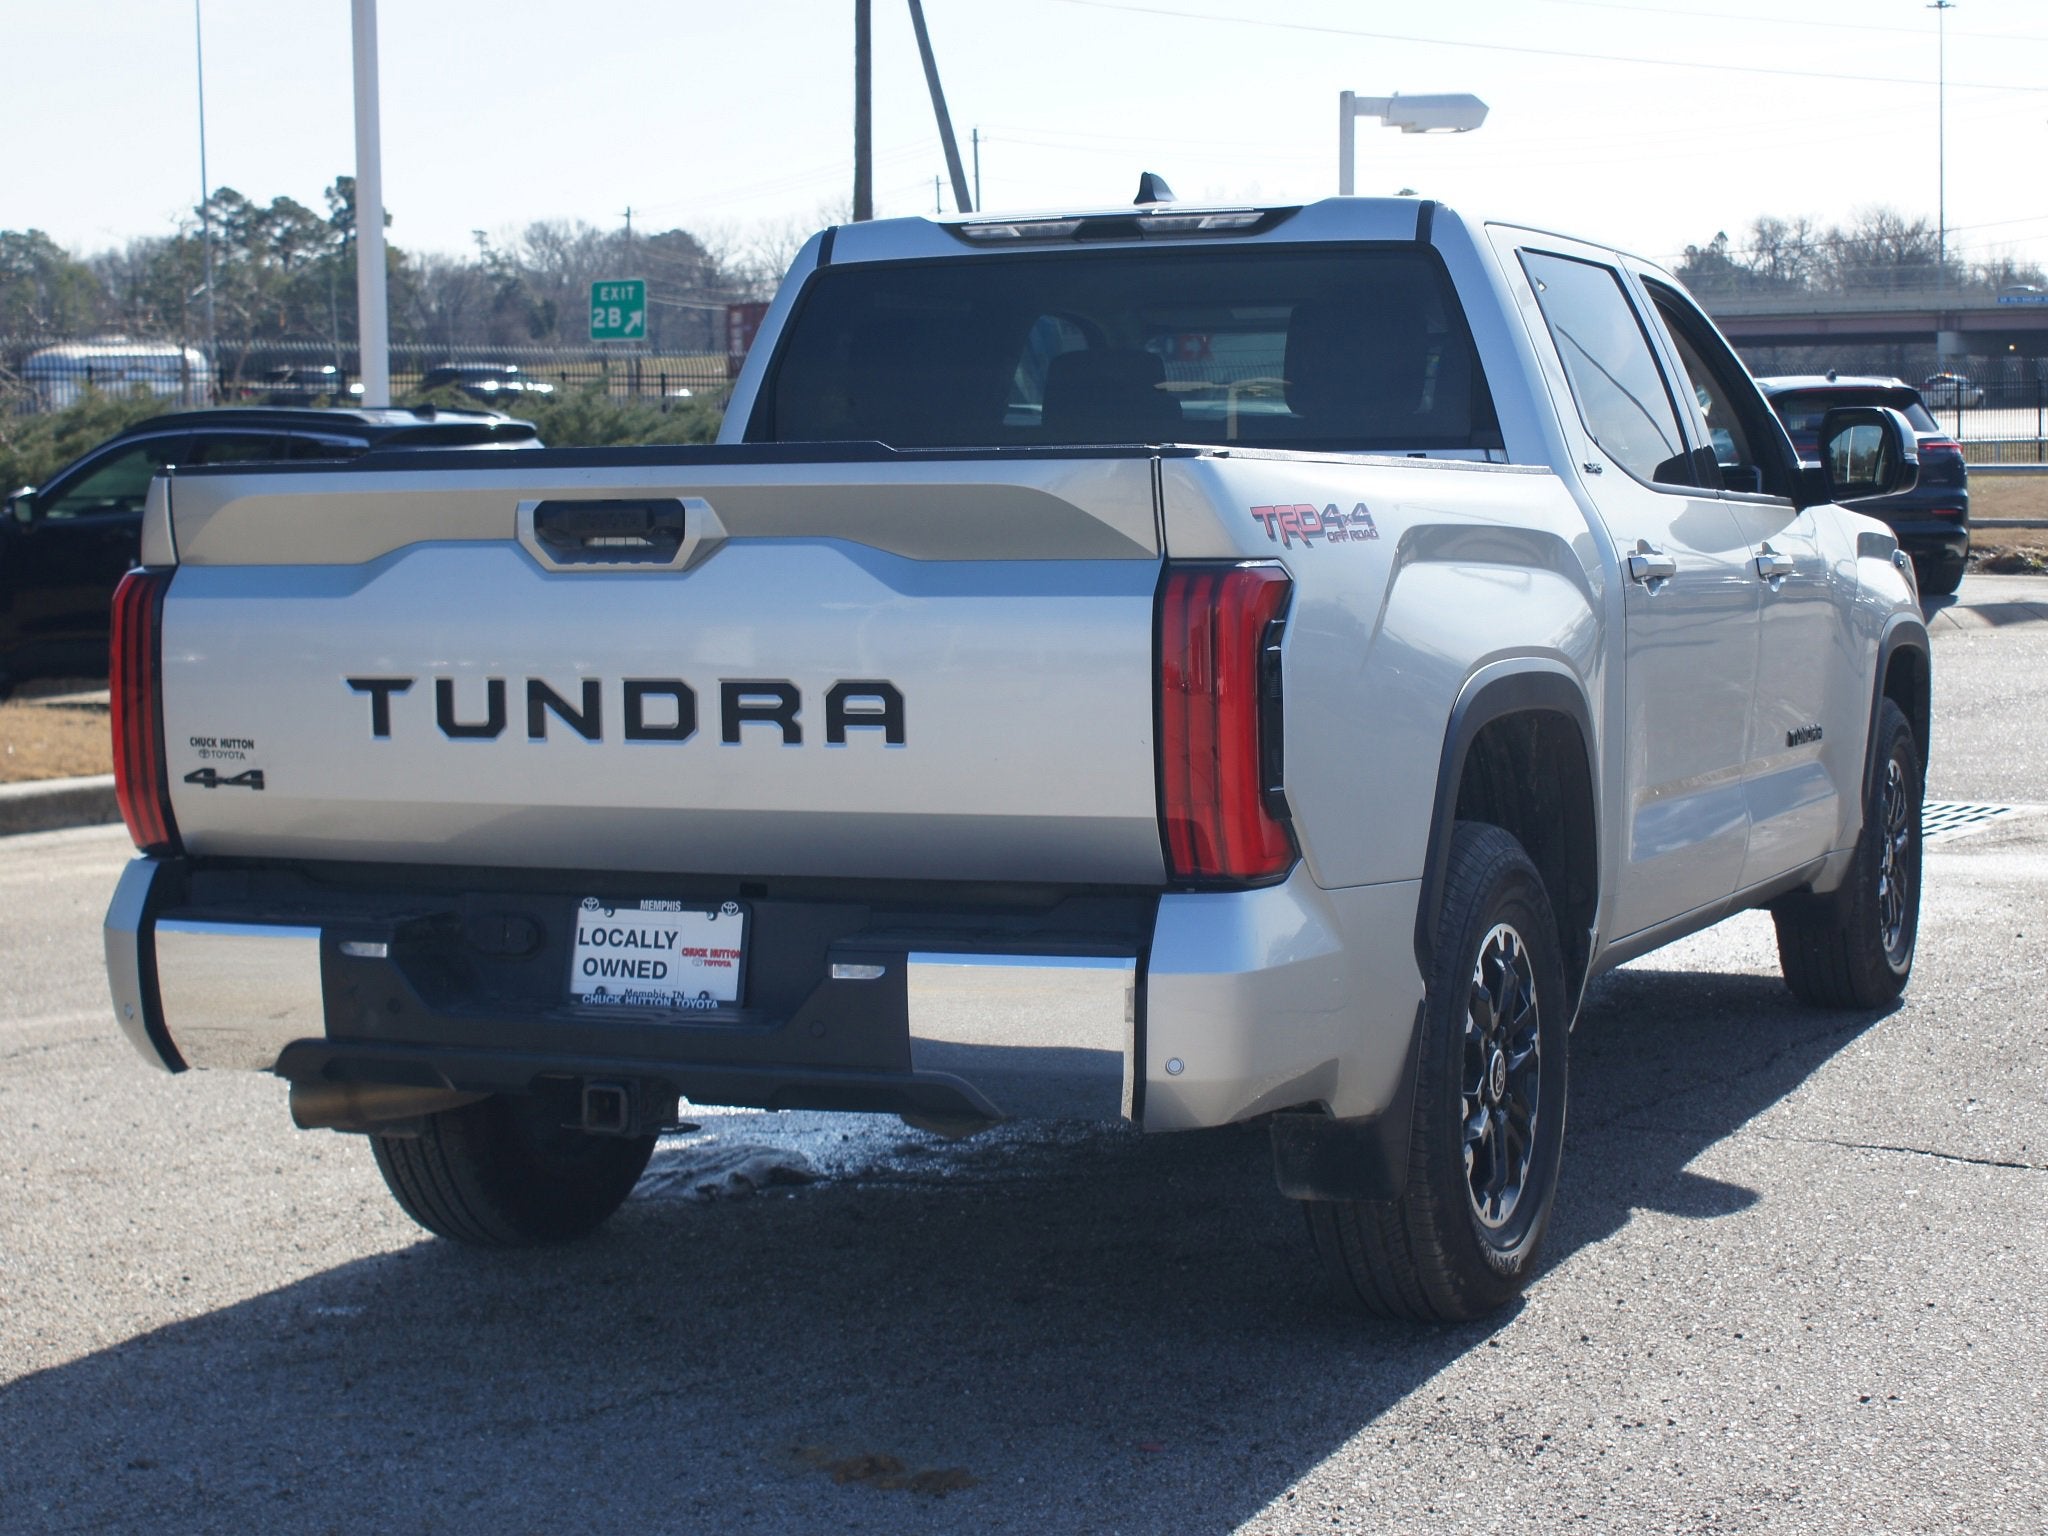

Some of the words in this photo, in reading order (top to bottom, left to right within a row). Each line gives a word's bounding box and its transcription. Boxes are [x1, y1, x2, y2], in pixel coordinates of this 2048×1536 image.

[601, 286, 635, 301] EXIT
[592, 307, 621, 328] 2B
[1326, 530, 1349, 544] OFF
[1350, 528, 1380, 542] ROAD
[346, 676, 906, 748] TUNDRA
[189, 736, 217, 748] CHUCK
[220, 738, 255, 750] HUTTON
[211, 749, 246, 761] TOYOTA
[640, 900, 681, 912] MEMPHIS
[578, 927, 679, 950] LOCALLY
[681, 946, 708, 958] CHUCK
[709, 948, 743, 959] HUTTON
[582, 957, 668, 980] OWNED
[703, 959, 732, 969] TOYOTA
[582, 993, 621, 1005] CHUCK
[626, 995, 671, 1007] HUTTON
[674, 999, 719, 1009] TOYOTA
